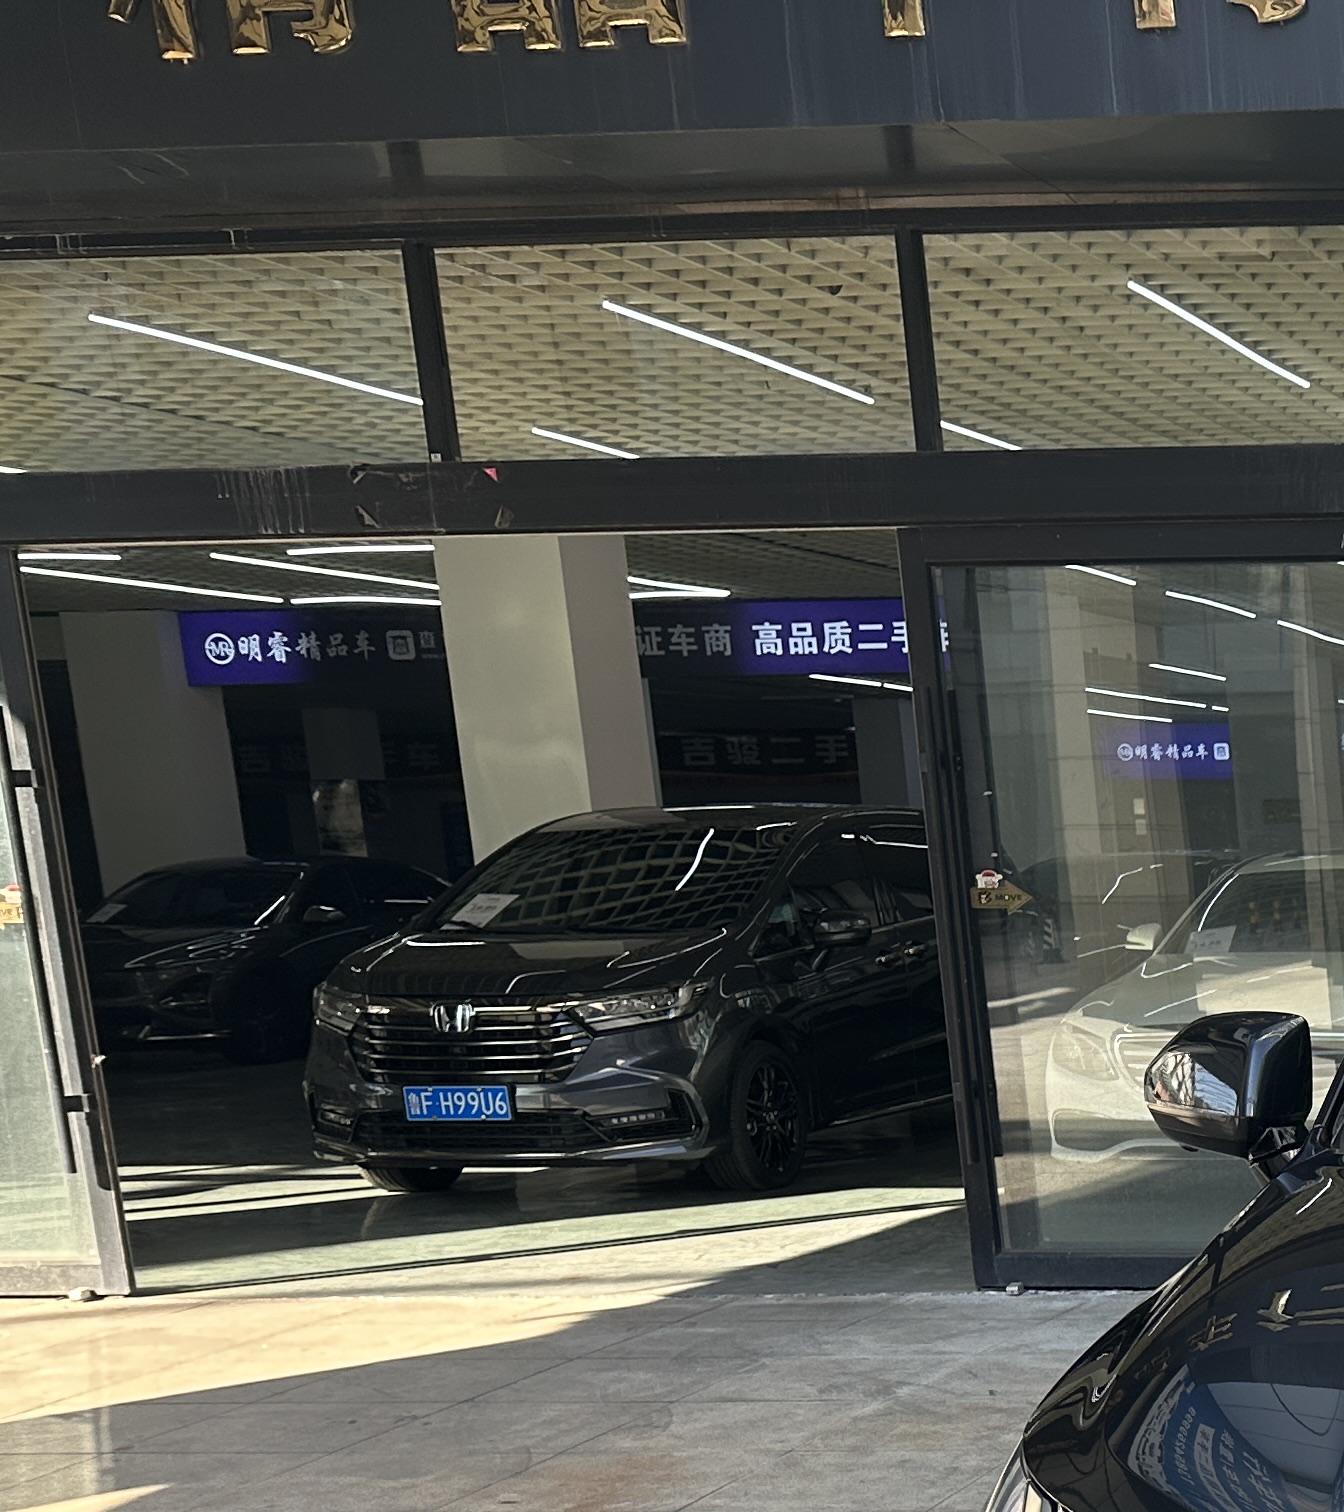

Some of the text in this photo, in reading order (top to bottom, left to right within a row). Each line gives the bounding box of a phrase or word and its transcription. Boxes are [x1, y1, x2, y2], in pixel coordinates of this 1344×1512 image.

[237, 630, 376, 664] 明睿精品车
